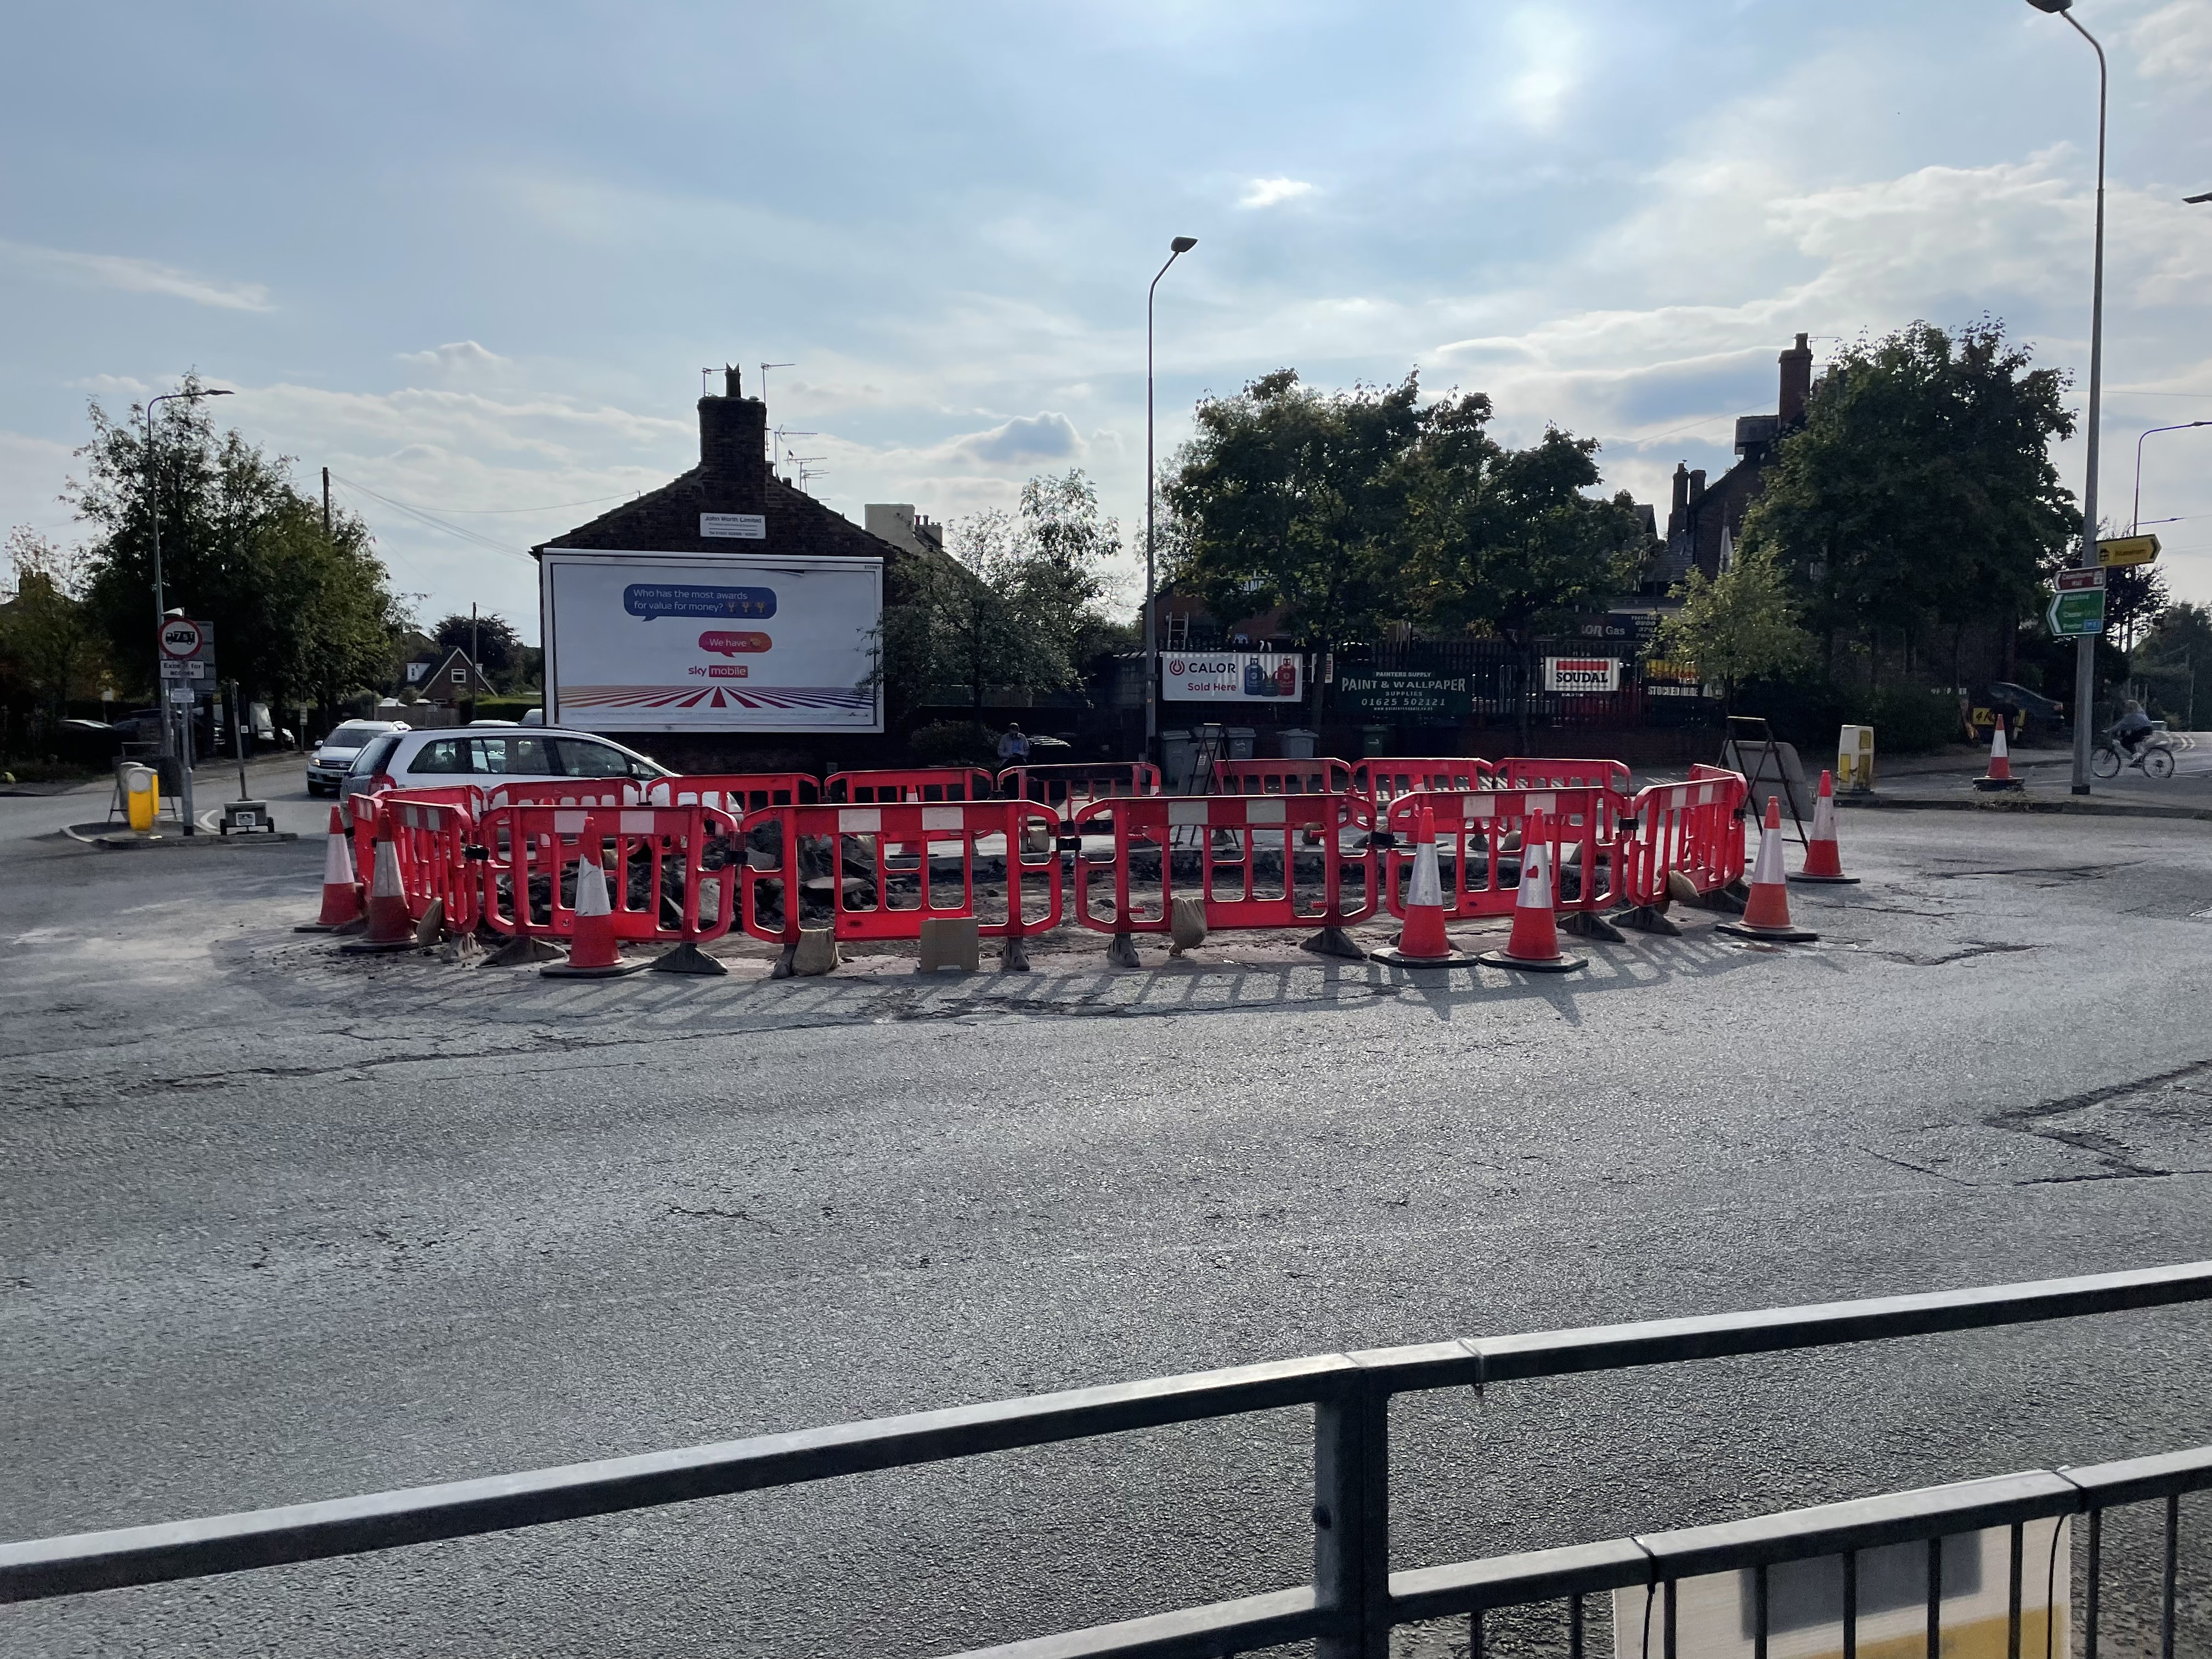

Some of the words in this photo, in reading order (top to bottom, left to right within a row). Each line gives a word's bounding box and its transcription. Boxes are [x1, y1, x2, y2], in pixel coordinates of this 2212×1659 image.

[633, 589, 654, 597] Who
[657, 590, 672, 598] has
[716, 591, 748, 600] awards
[689, 603, 724, 613] money?
[1605, 626, 1626, 635] Gas
[710, 638, 724, 646] We
[726, 639, 747, 647] have
[689, 665, 707, 677] sky
[711, 667, 746, 675] mobile
[1189, 662, 1236, 674] CALOR
[1556, 673, 1609, 682] SOUDAL
[1188, 682, 1210, 691] Sold
[1214, 683, 1236, 691] Here
[1342, 677, 1378, 691] PAINT
[1393, 678, 1466, 692] WALLPAPER
